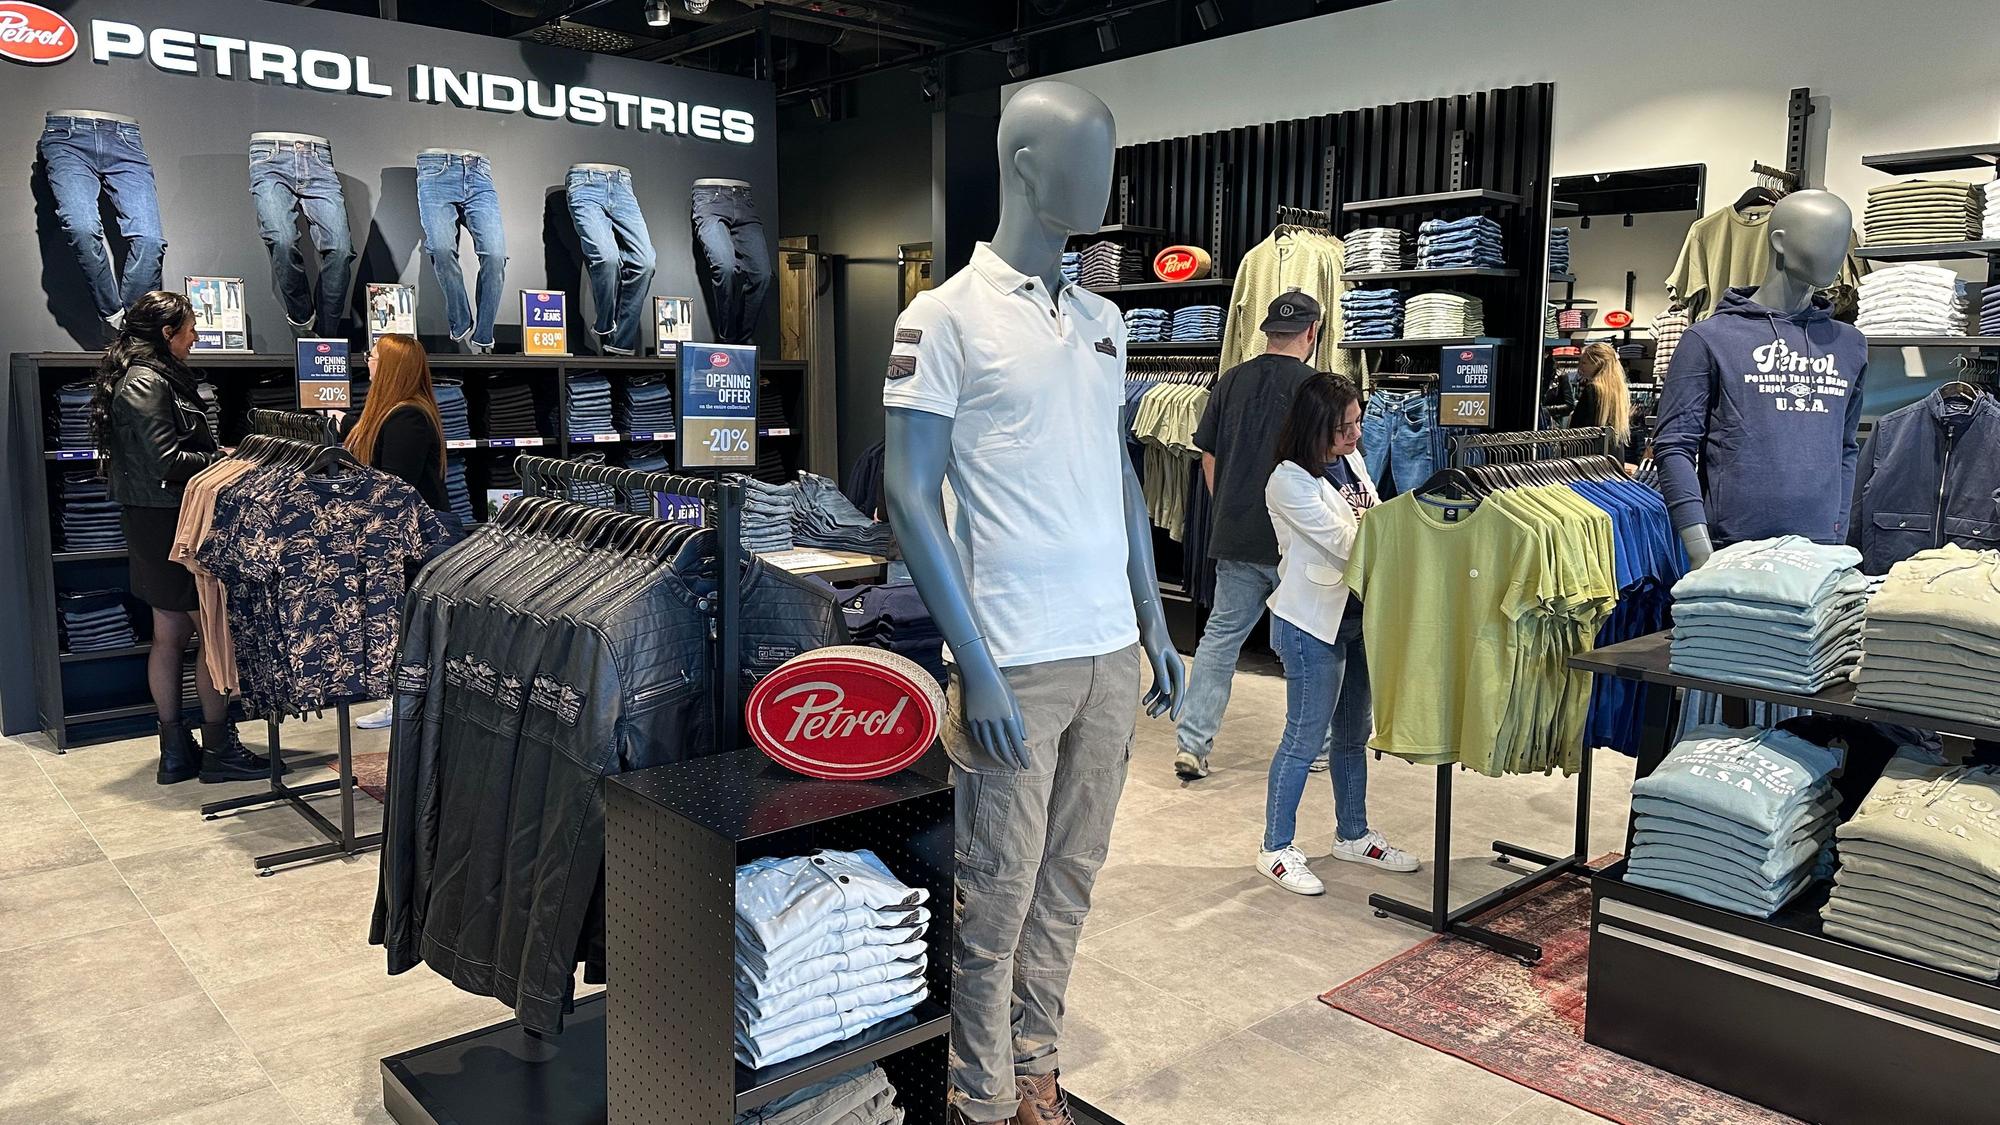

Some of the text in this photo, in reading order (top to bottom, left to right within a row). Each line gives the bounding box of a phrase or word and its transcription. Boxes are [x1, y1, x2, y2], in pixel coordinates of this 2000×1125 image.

[91, 19, 755, 144] PETROL INDUSTRIES
[533, 307, 541, 321] 2
[314, 355, 346, 365] OPENING
[323, 364, 347, 374] OFFER
[1456, 364, 1488, 375] OPENING
[706, 373, 751, 389] OPENING
[1464, 374, 1488, 384] OFFER
[313, 387, 347, 401] -20%
[718, 388, 751, 404] OFFER
[1453, 400, 1486, 417] -20%
[1775, 397, 1830, 413] U.S.A.
[702, 428, 750, 452] -20%
[667, 504, 674, 520] 2
[1689, 765, 1758, 796] U.S.A.
